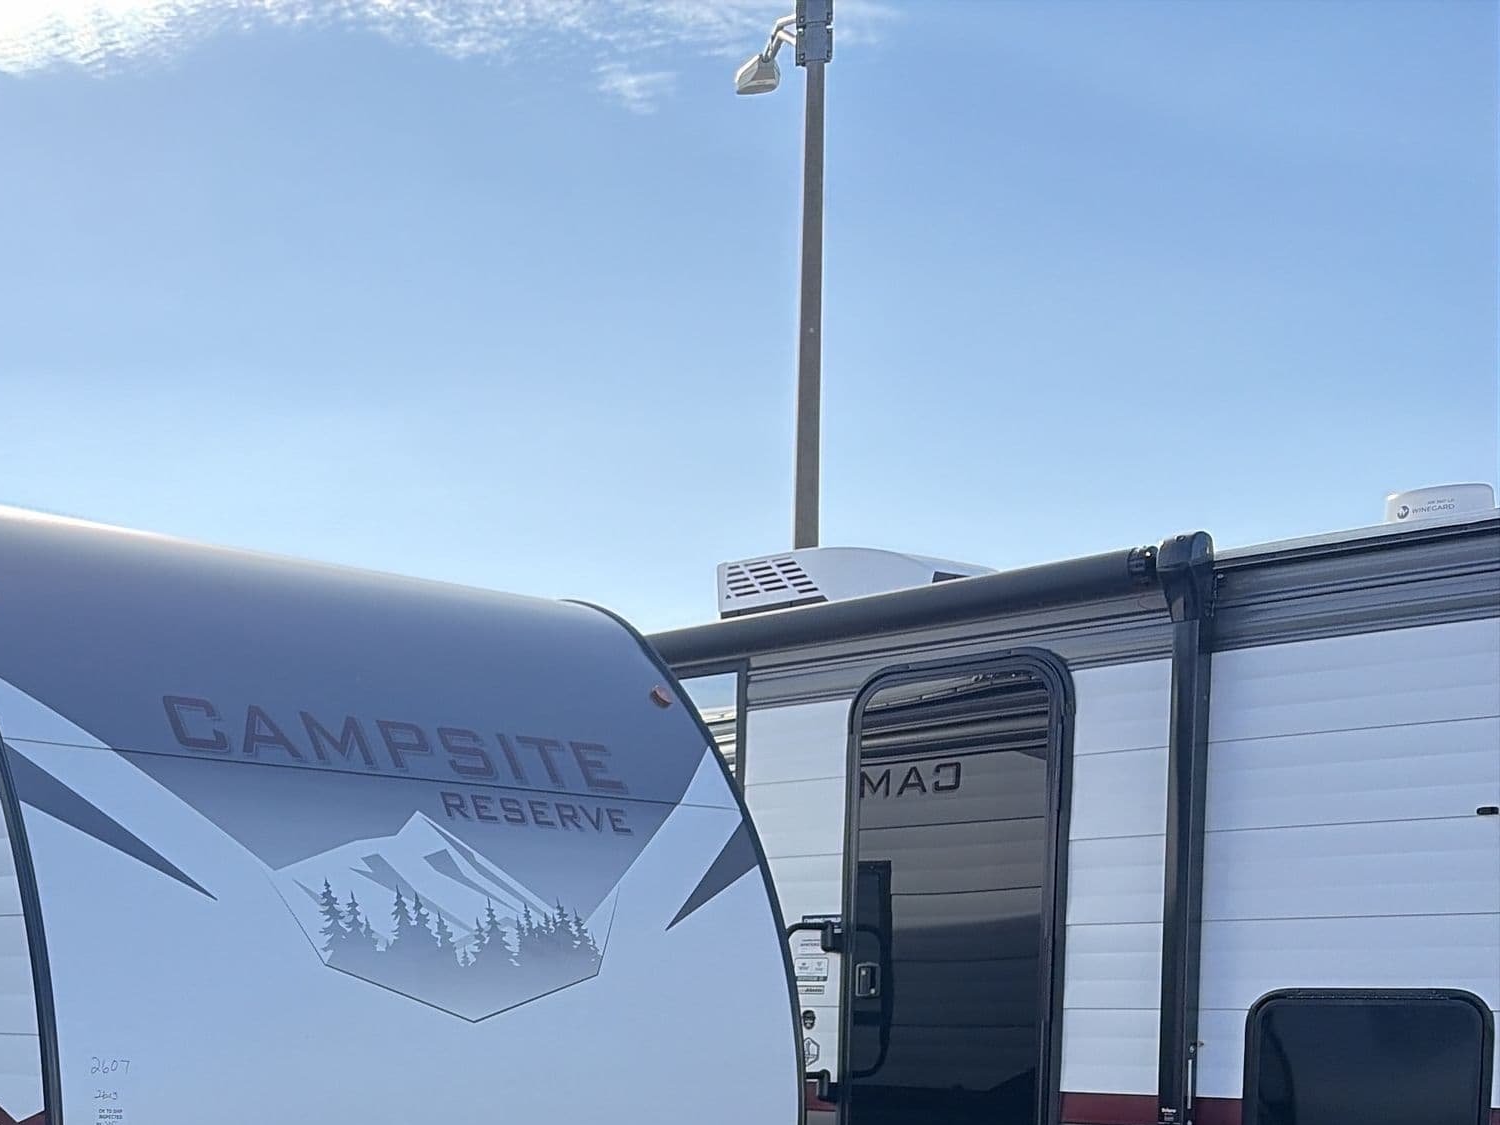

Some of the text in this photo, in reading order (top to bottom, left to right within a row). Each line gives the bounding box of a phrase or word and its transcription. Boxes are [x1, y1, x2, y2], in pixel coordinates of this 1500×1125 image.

[162, 695, 628, 791] CAMPSITE
[441, 792, 632, 834] RESERVE
[91, 1056, 130, 1075] 2607
